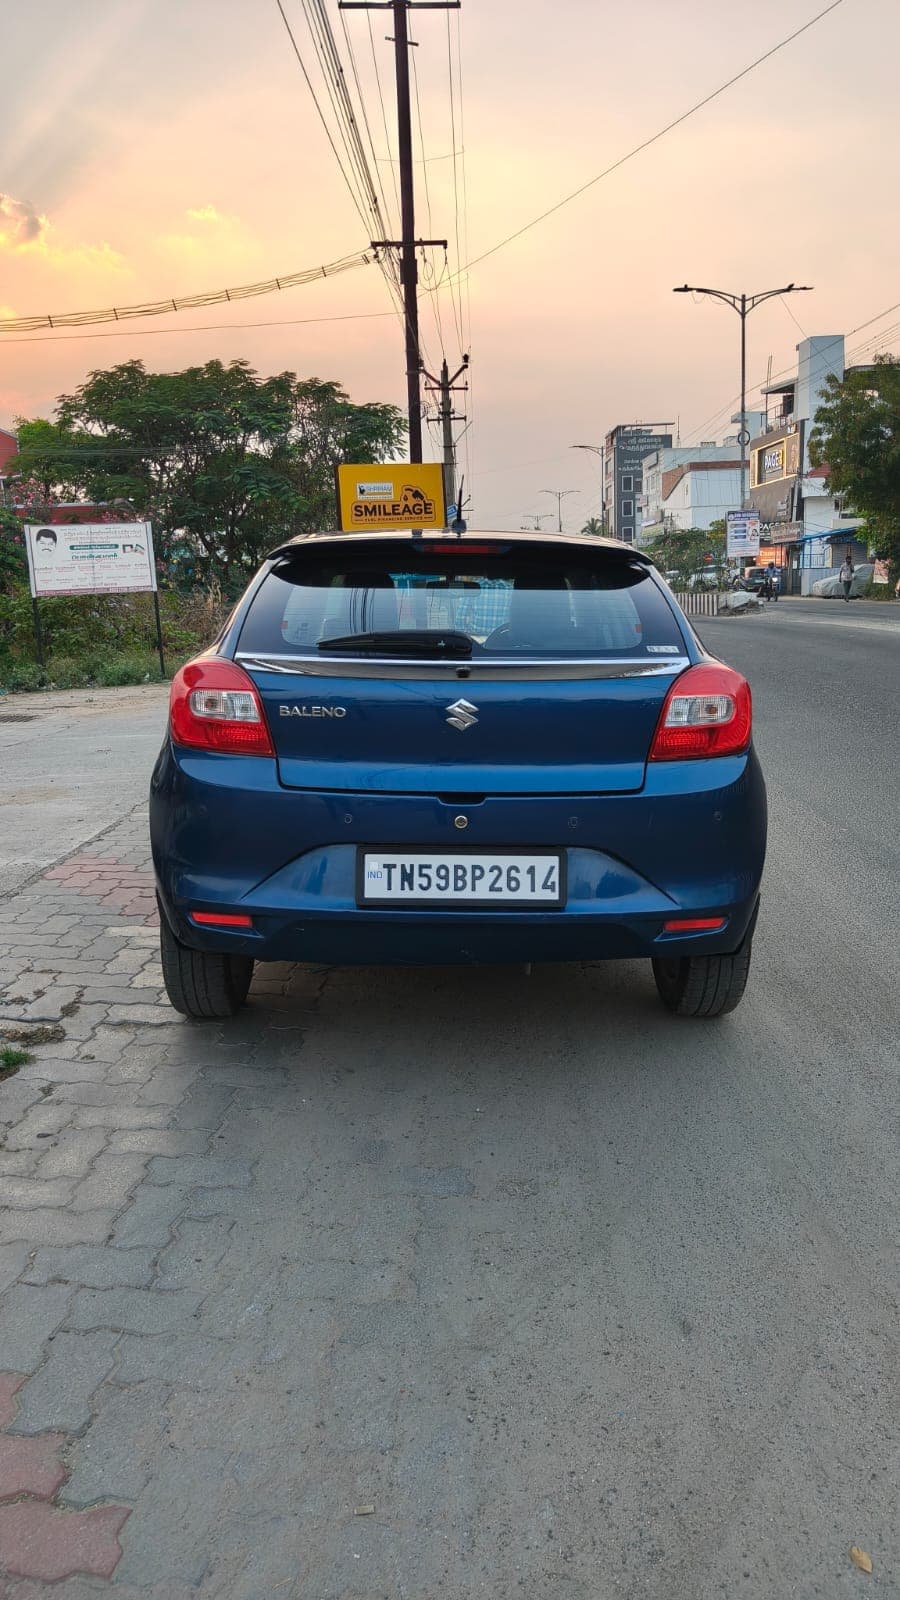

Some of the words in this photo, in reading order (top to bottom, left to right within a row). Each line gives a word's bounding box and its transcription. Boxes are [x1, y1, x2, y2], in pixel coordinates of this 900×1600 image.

[354, 502, 433, 517] SMILEAGE
[279, 705, 347, 718] BALENO
[367, 870, 383, 879] IND
[383, 864, 556, 893] TN59BP2614
